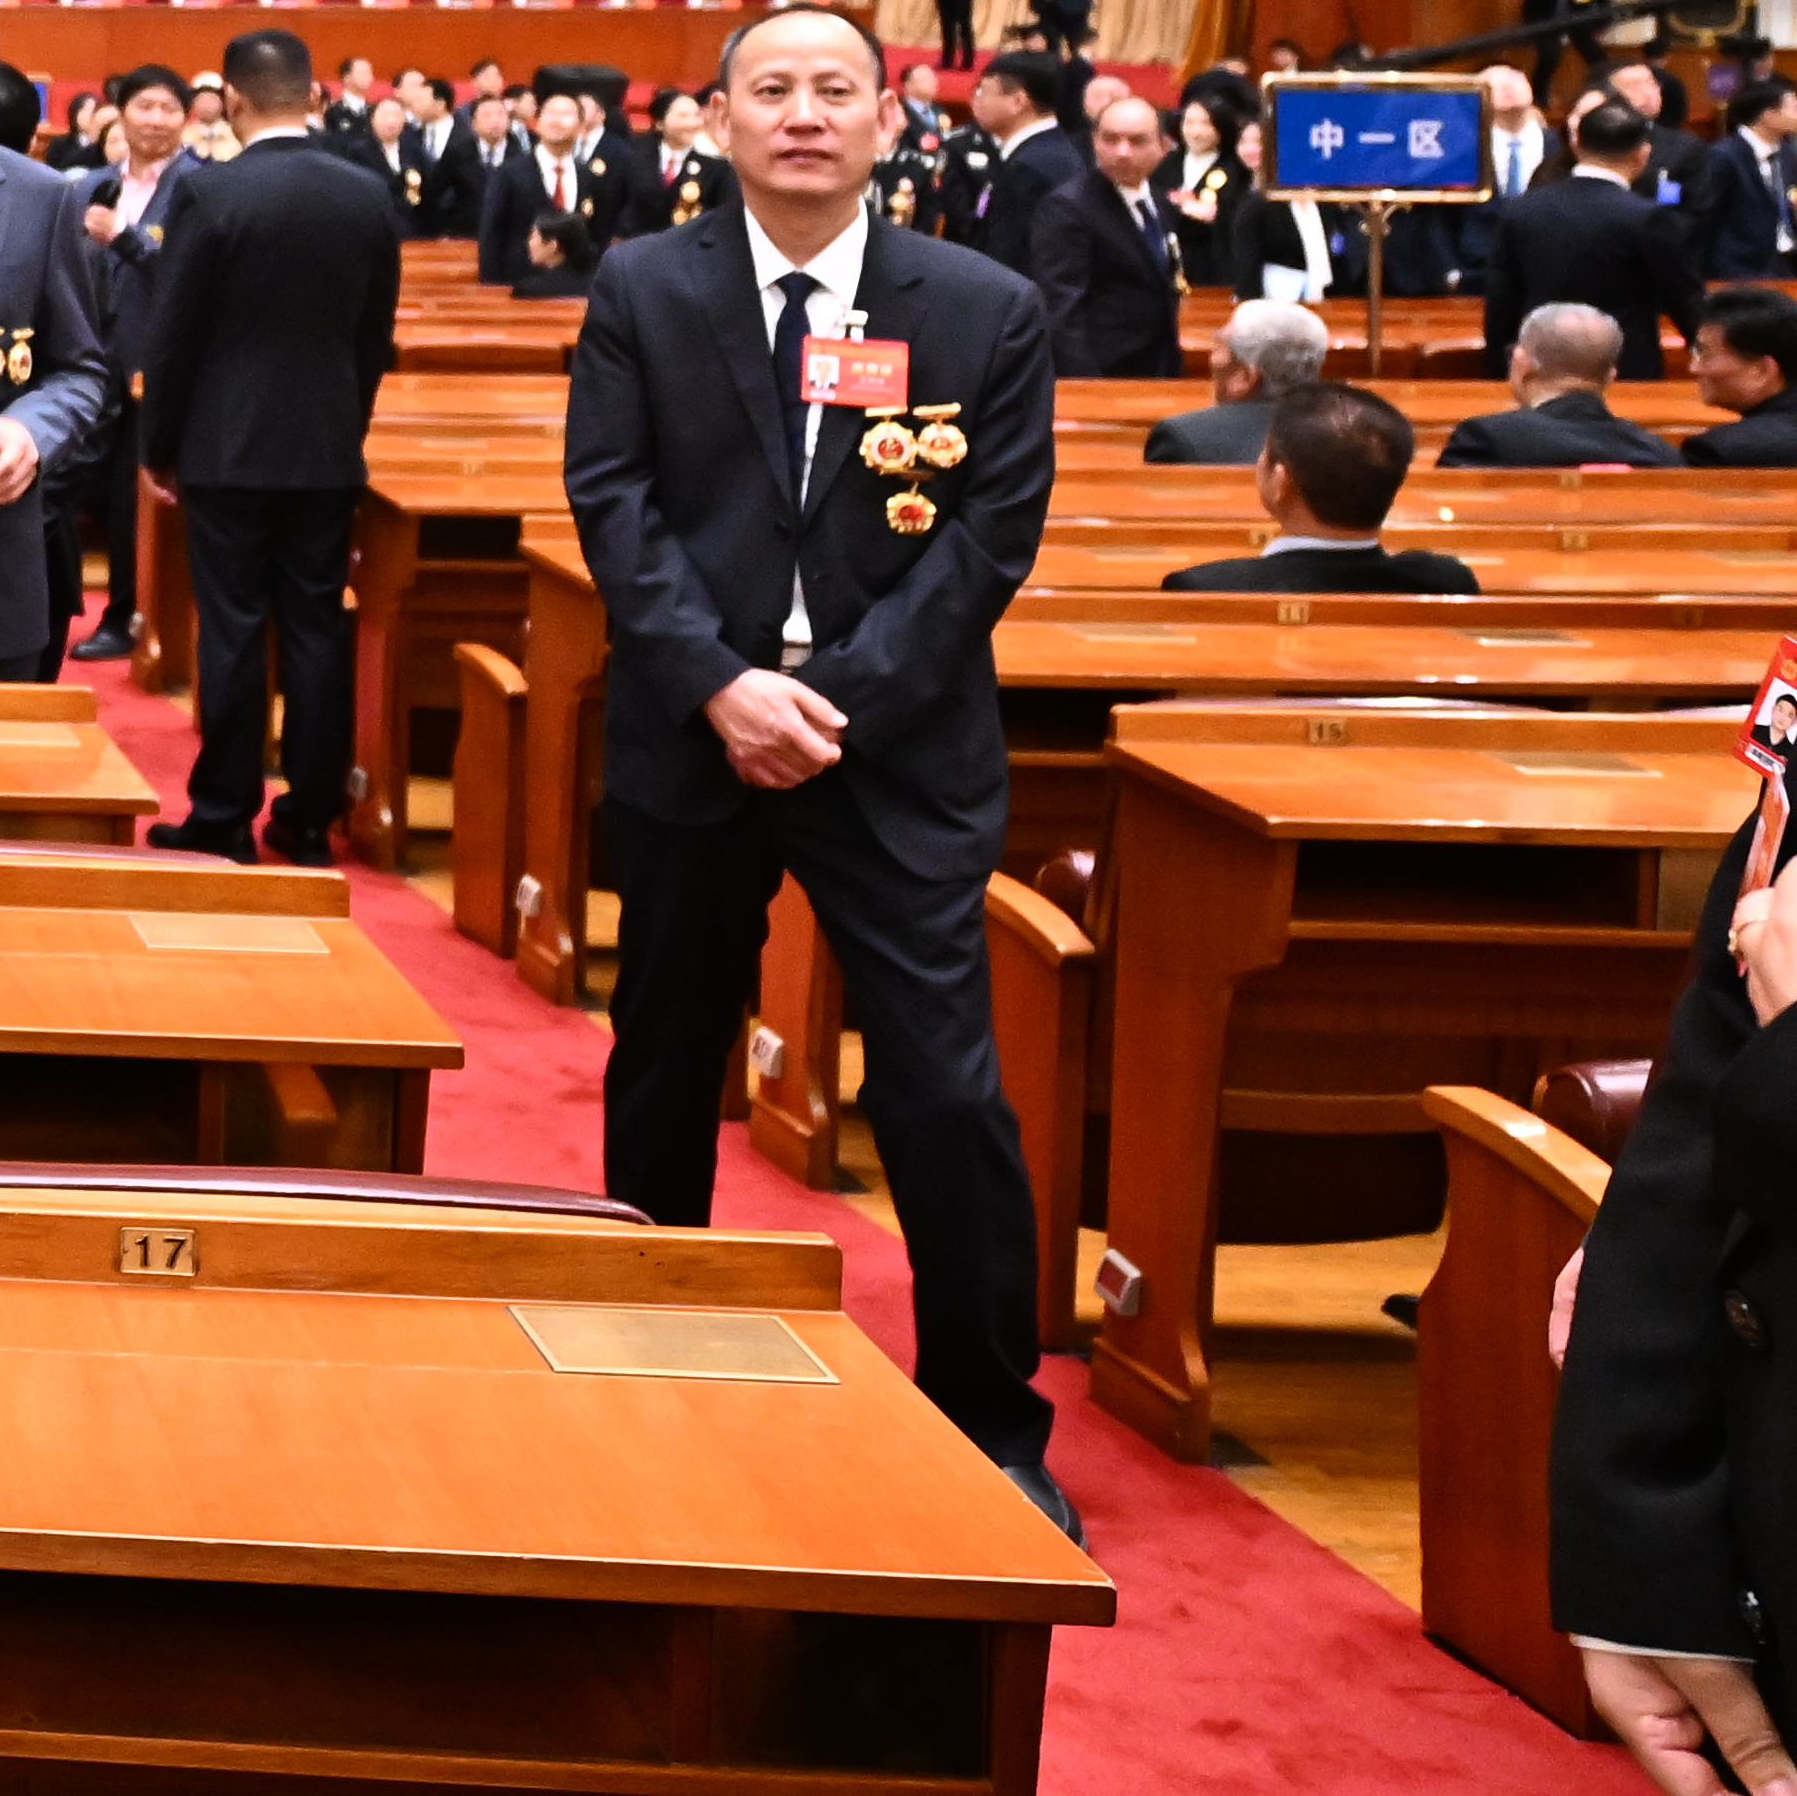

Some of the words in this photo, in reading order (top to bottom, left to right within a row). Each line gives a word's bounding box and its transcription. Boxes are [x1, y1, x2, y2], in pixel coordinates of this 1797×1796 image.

[1310, 118, 1445, 159] 中一区
[135, 1234, 189, 1269] 17
